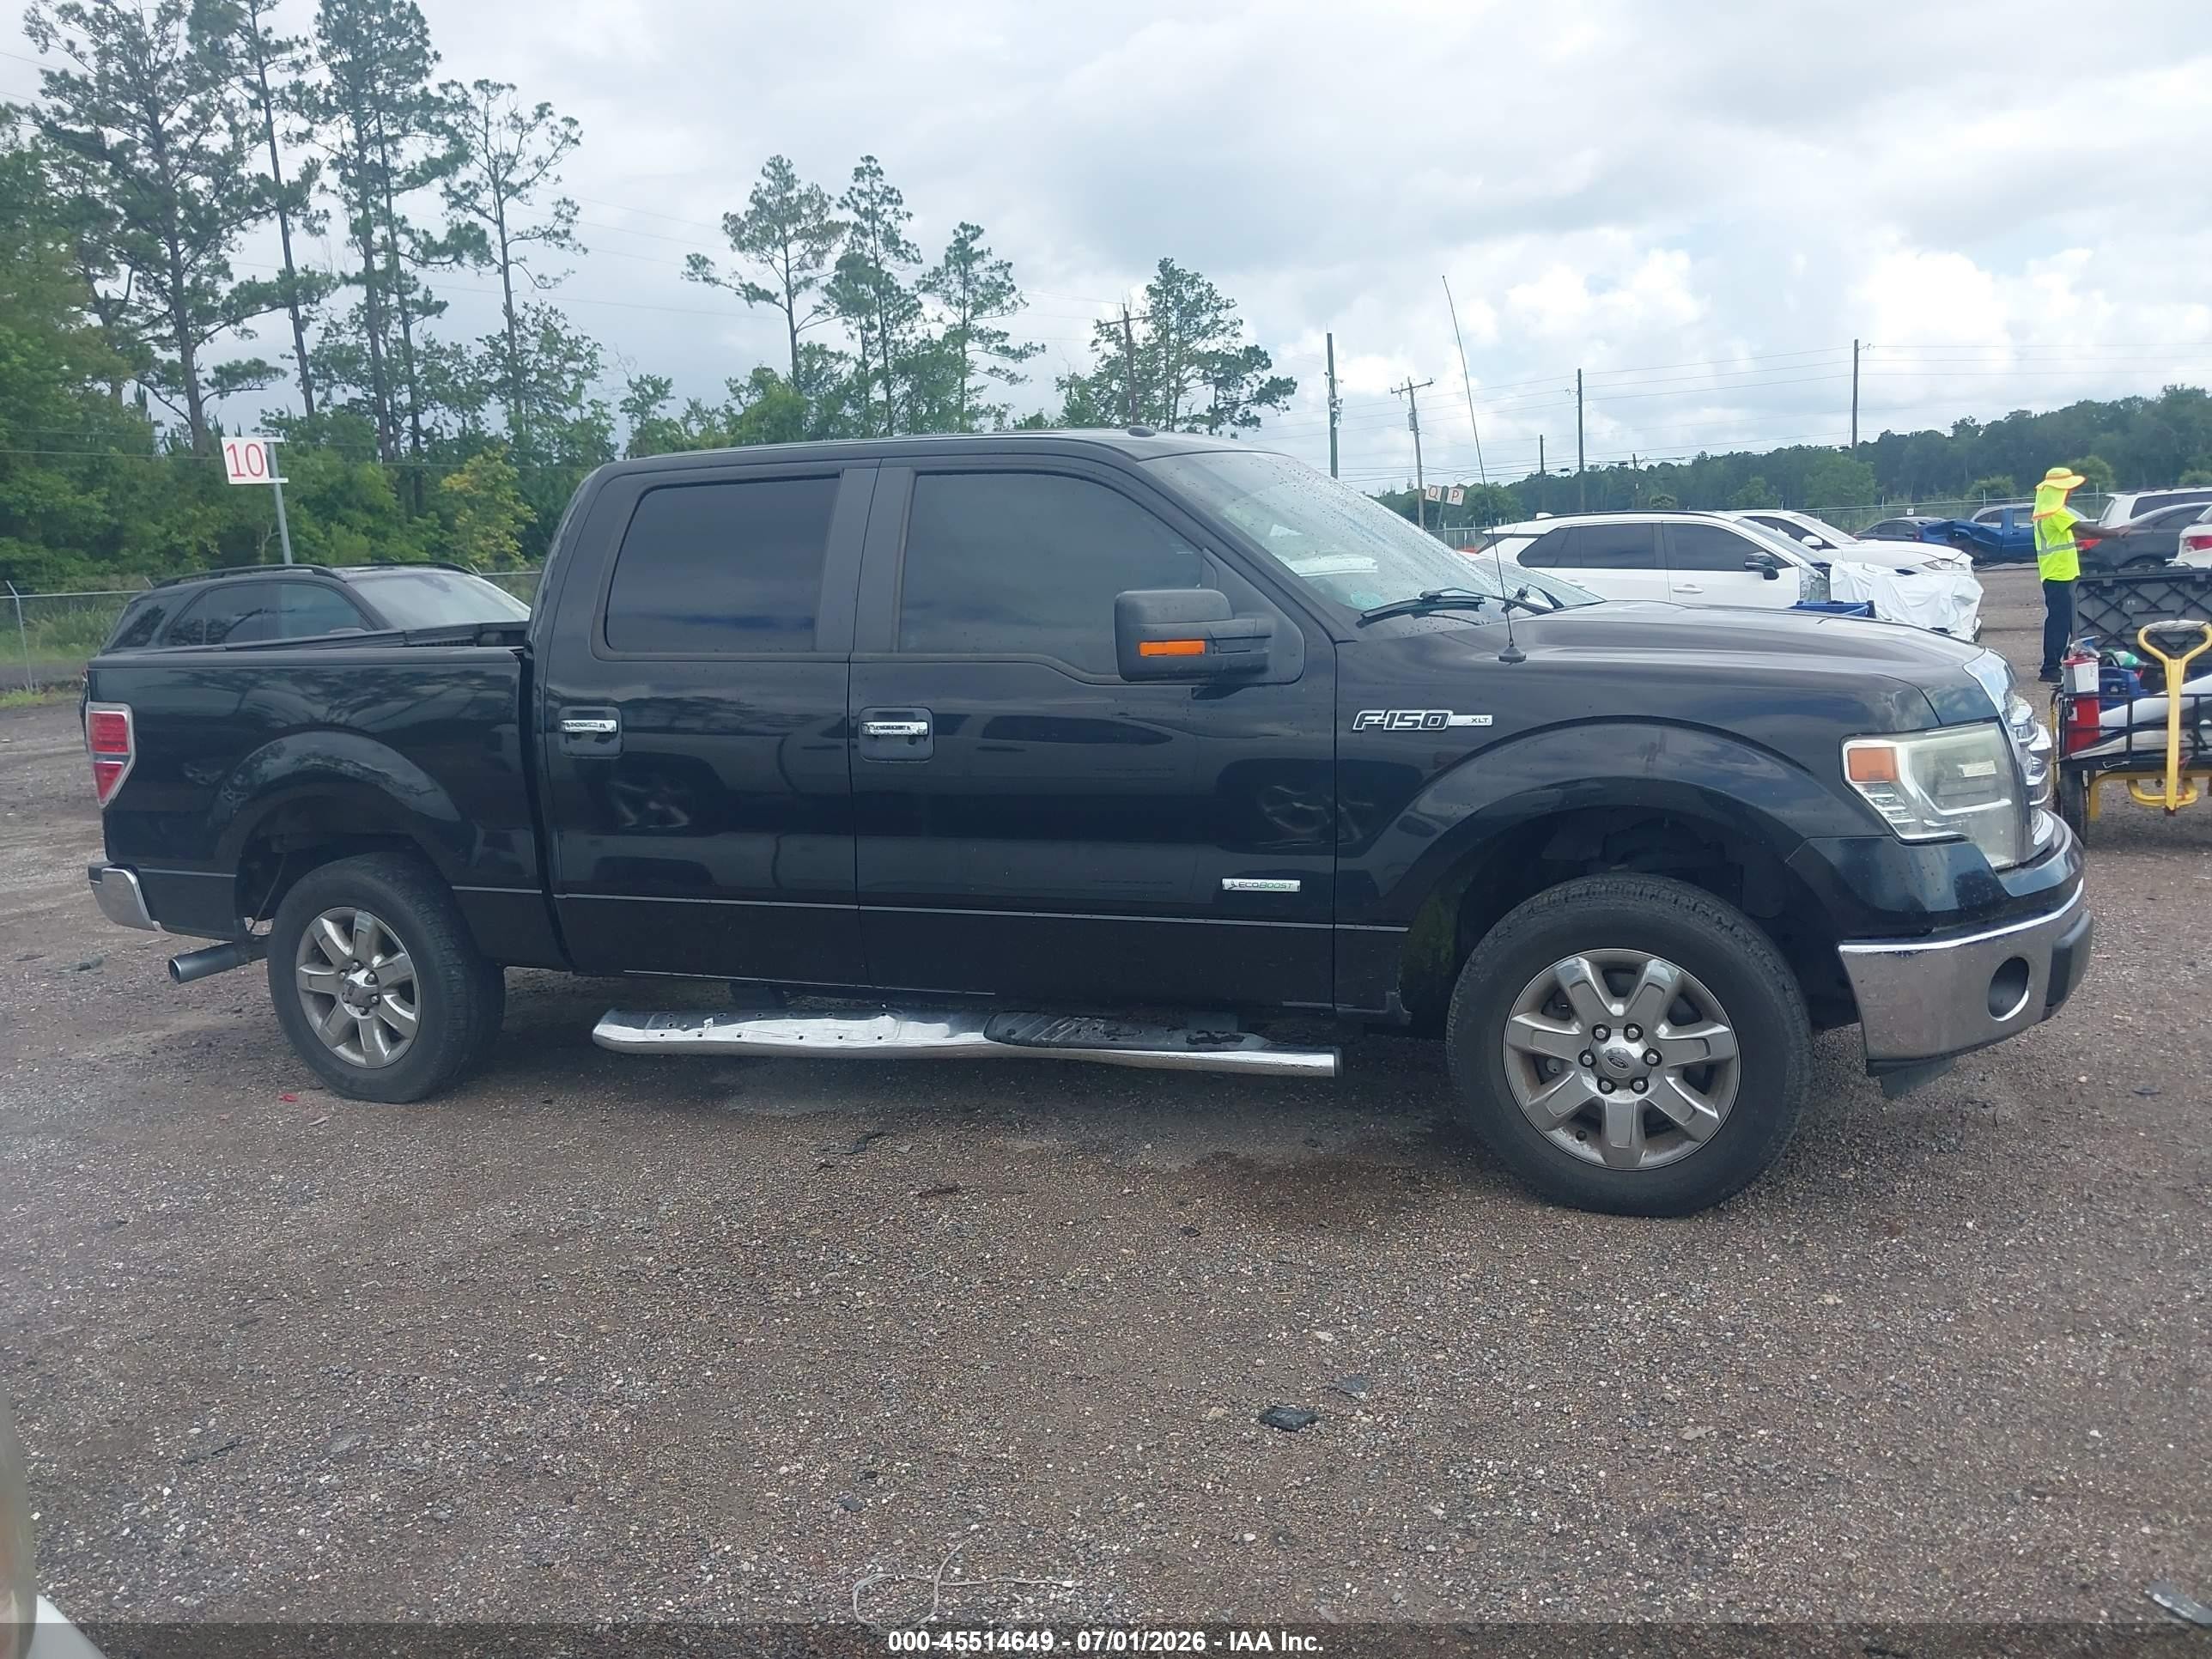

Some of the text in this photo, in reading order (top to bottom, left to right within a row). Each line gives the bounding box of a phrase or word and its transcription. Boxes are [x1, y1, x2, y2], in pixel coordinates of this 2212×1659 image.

[226, 443, 264, 477] 10
[1428, 485, 1438, 501] Q
[1451, 489, 1460, 502] P
[1352, 710, 1454, 731] F-150
